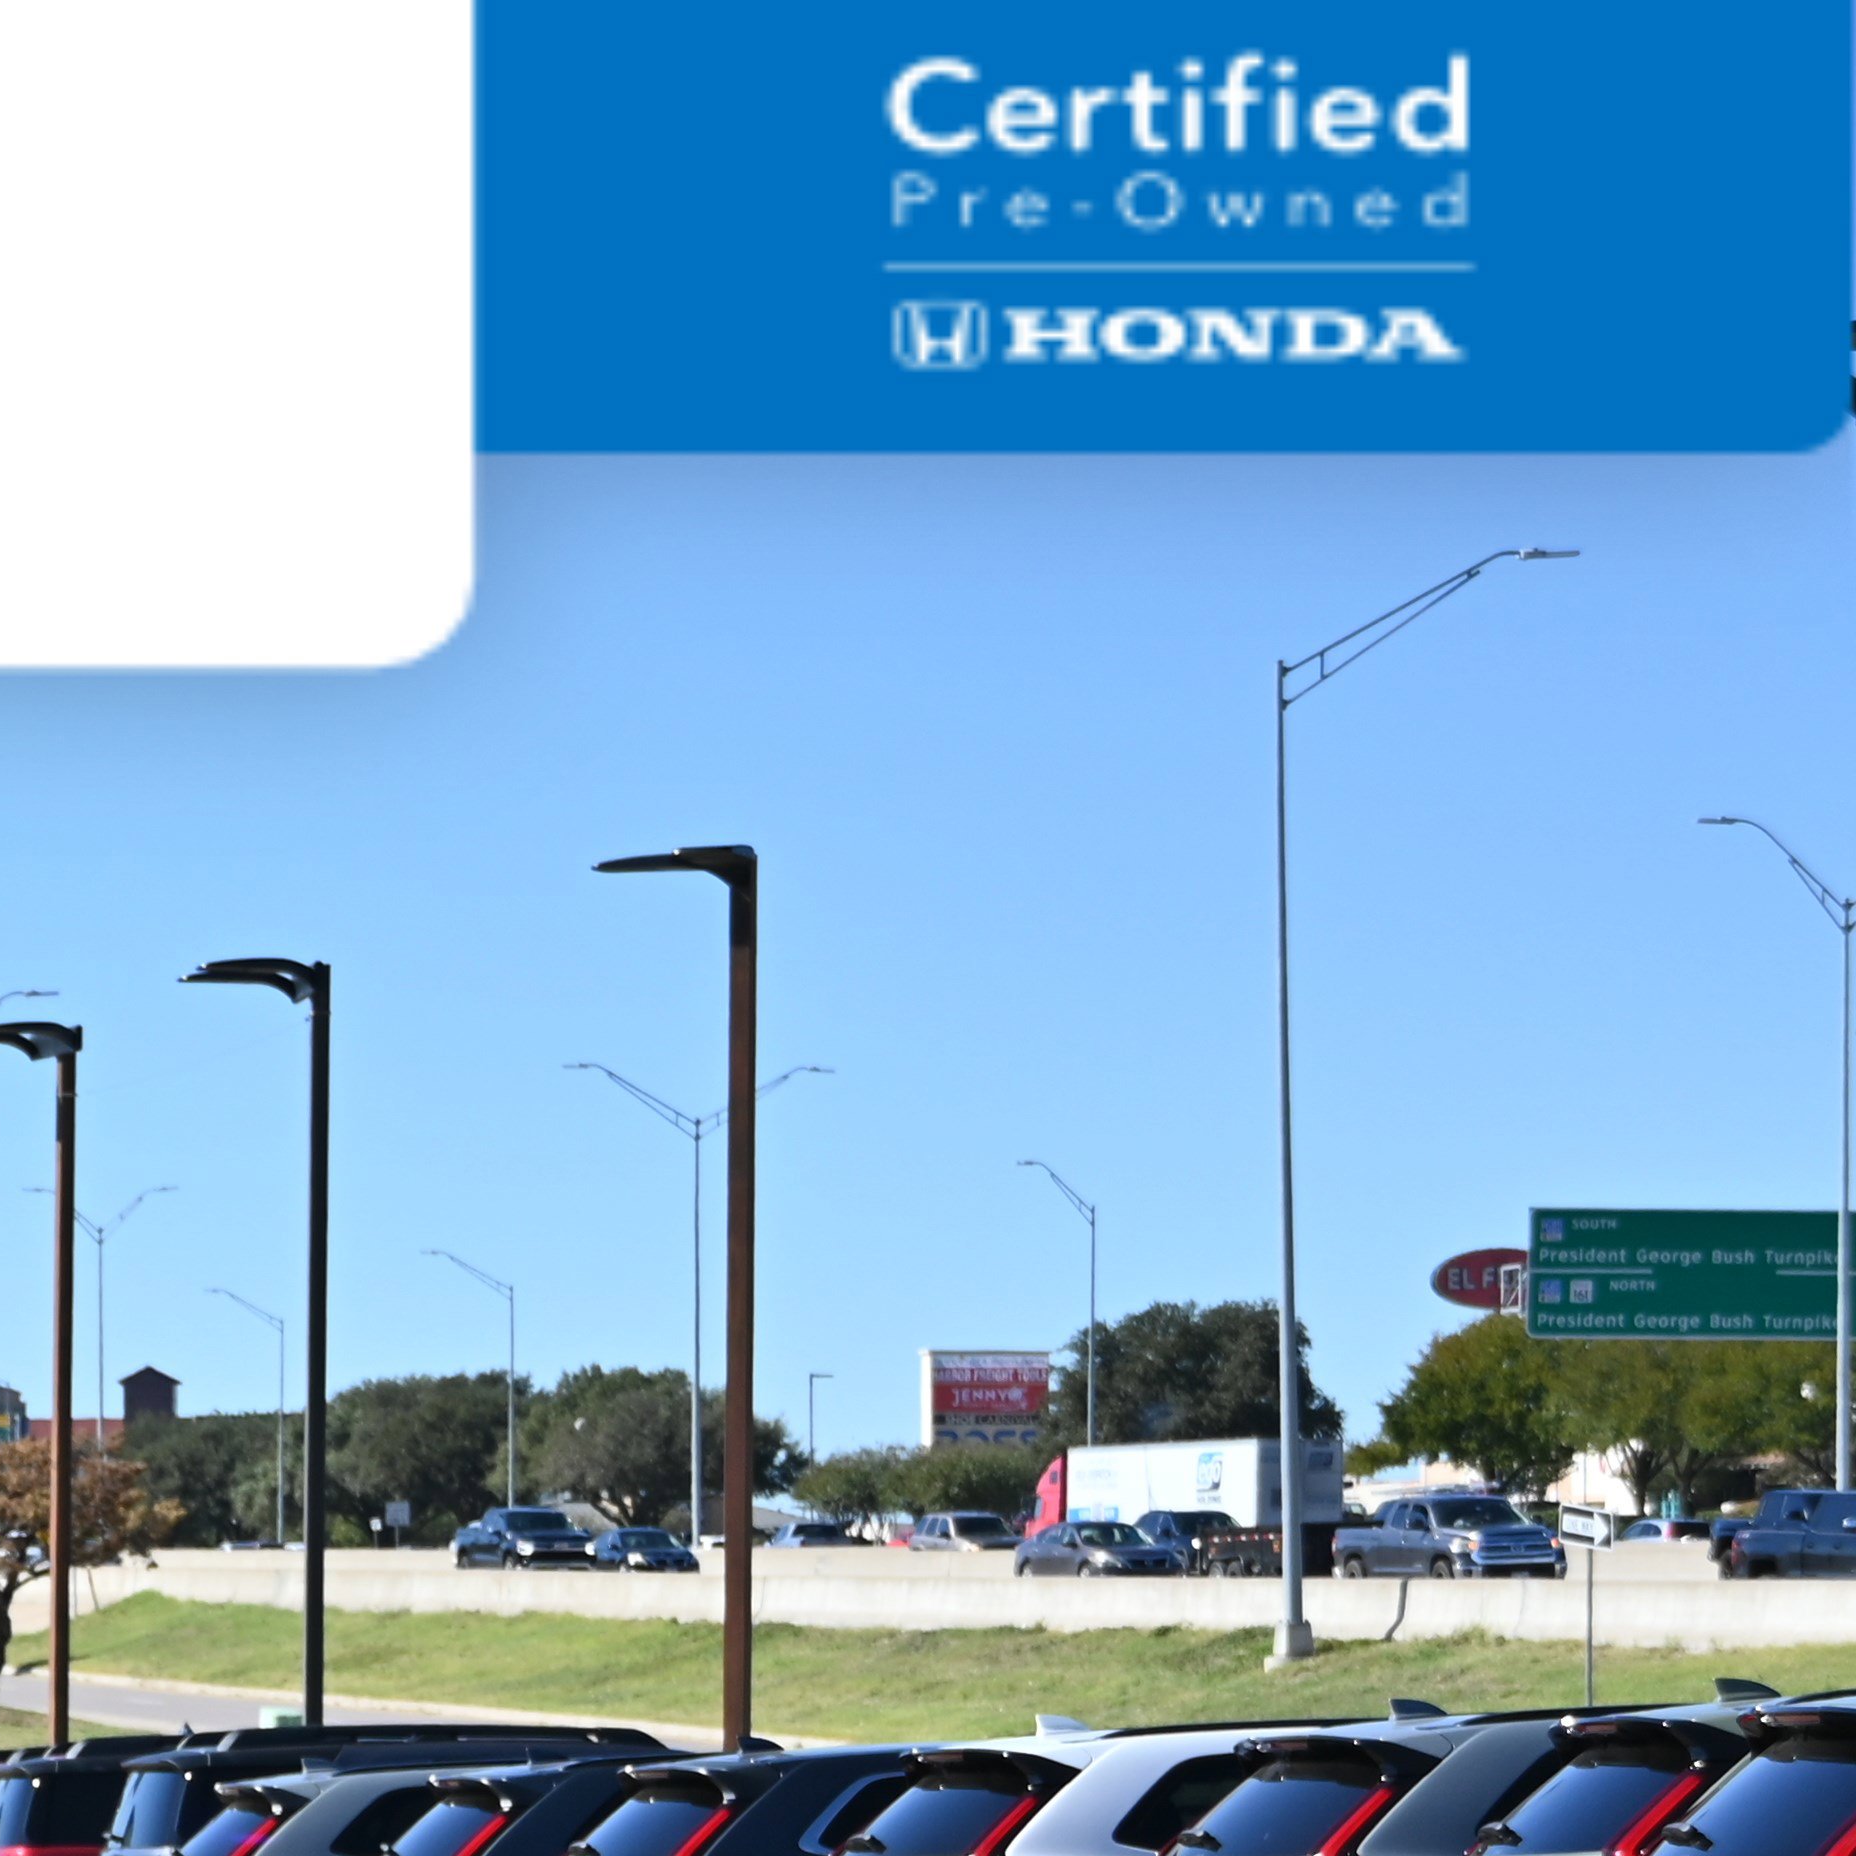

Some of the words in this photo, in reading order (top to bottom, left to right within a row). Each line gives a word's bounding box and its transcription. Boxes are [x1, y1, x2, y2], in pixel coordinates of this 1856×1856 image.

[1571, 1218, 1618, 1231] SOUTH
[1539, 1248, 1627, 1264] President
[1636, 1249, 1702, 1268] George
[1711, 1249, 1756, 1265] Bush
[1609, 1279, 1656, 1292] NORTH
[1537, 1313, 1626, 1329] President
[1634, 1313, 1701, 1333] George
[1709, 1314, 1754, 1329] Bush
